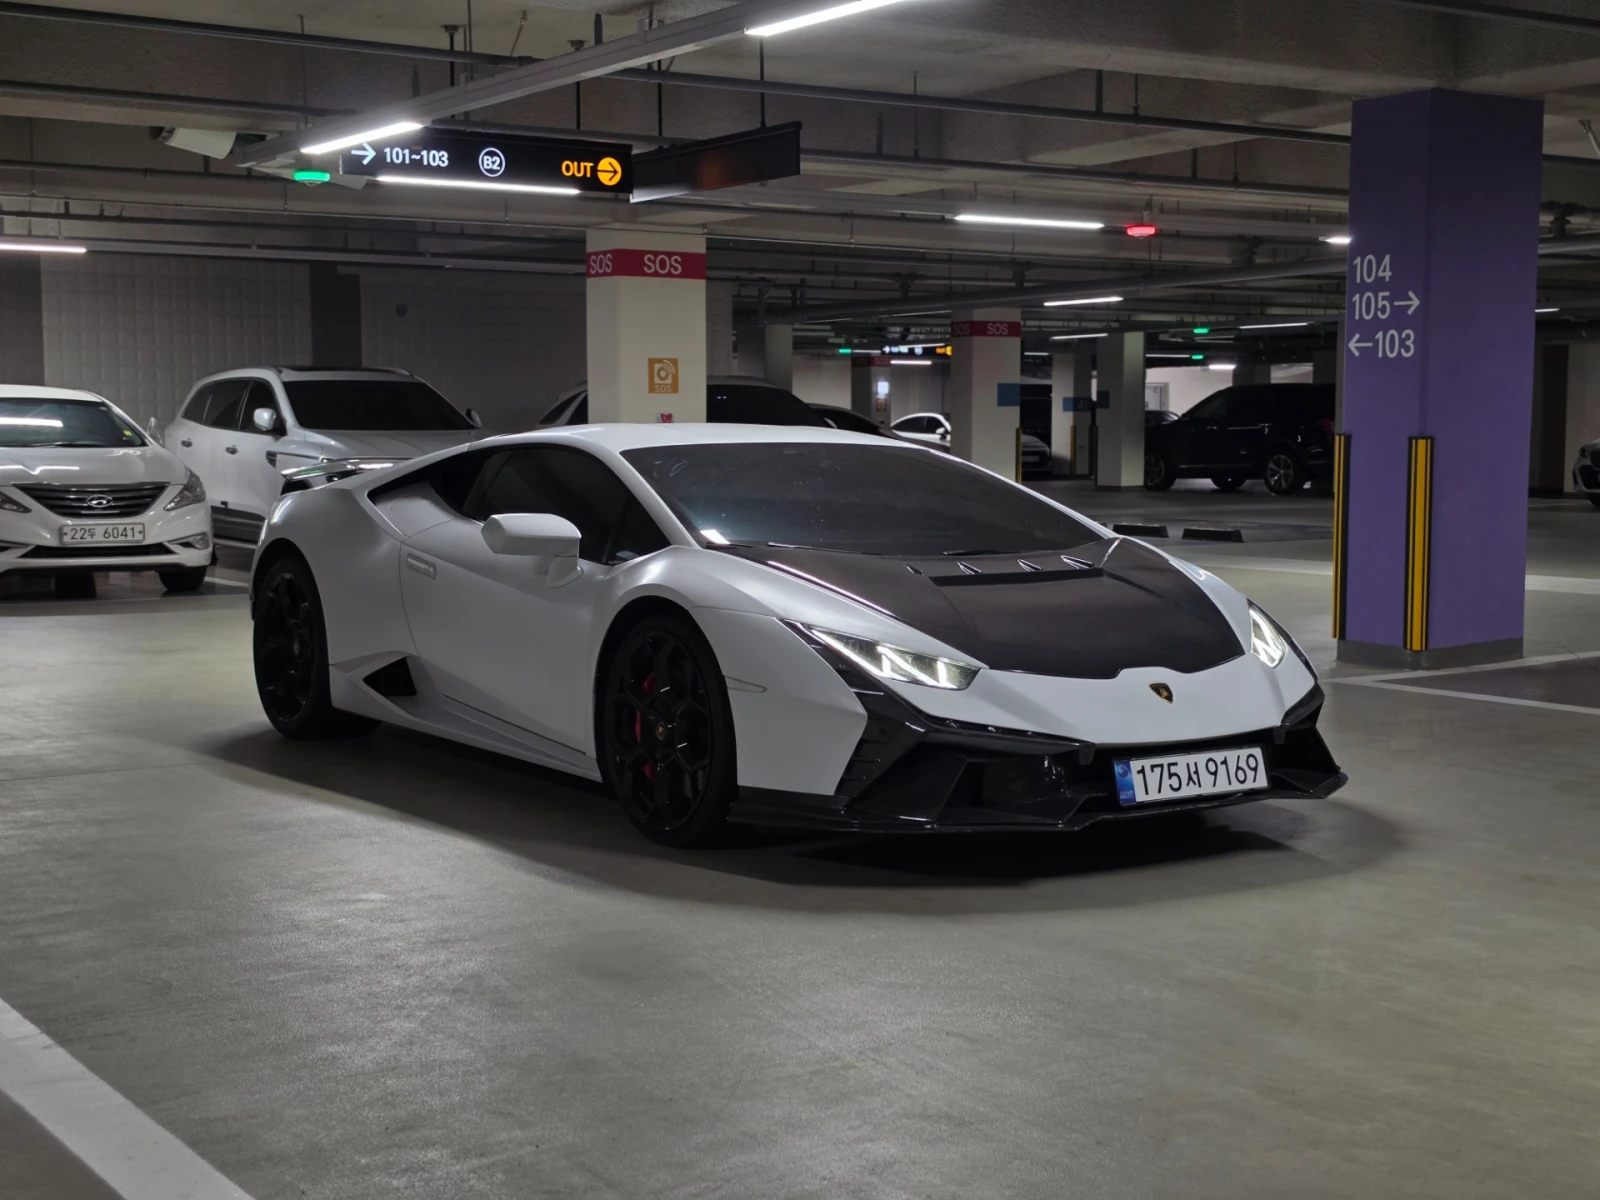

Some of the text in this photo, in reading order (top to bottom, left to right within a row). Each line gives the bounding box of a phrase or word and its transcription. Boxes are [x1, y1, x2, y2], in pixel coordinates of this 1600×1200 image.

[383, 147, 449, 167] 101~103
[483, 155, 501, 170] B2
[561, 160, 594, 177] OUT
[589, 254, 613, 274] SOS
[643, 254, 682, 274] SOS
[1353, 254, 1392, 283] 104
[1352, 292, 1391, 320] 105
[952, 323, 970, 335] SOS
[986, 323, 1009, 335] SOS
[1375, 329, 1415, 358] 103
[654, 384, 672, 393] SOS
[103, 526, 136, 539] 6041
[1205, 753, 1259, 788] 9169
